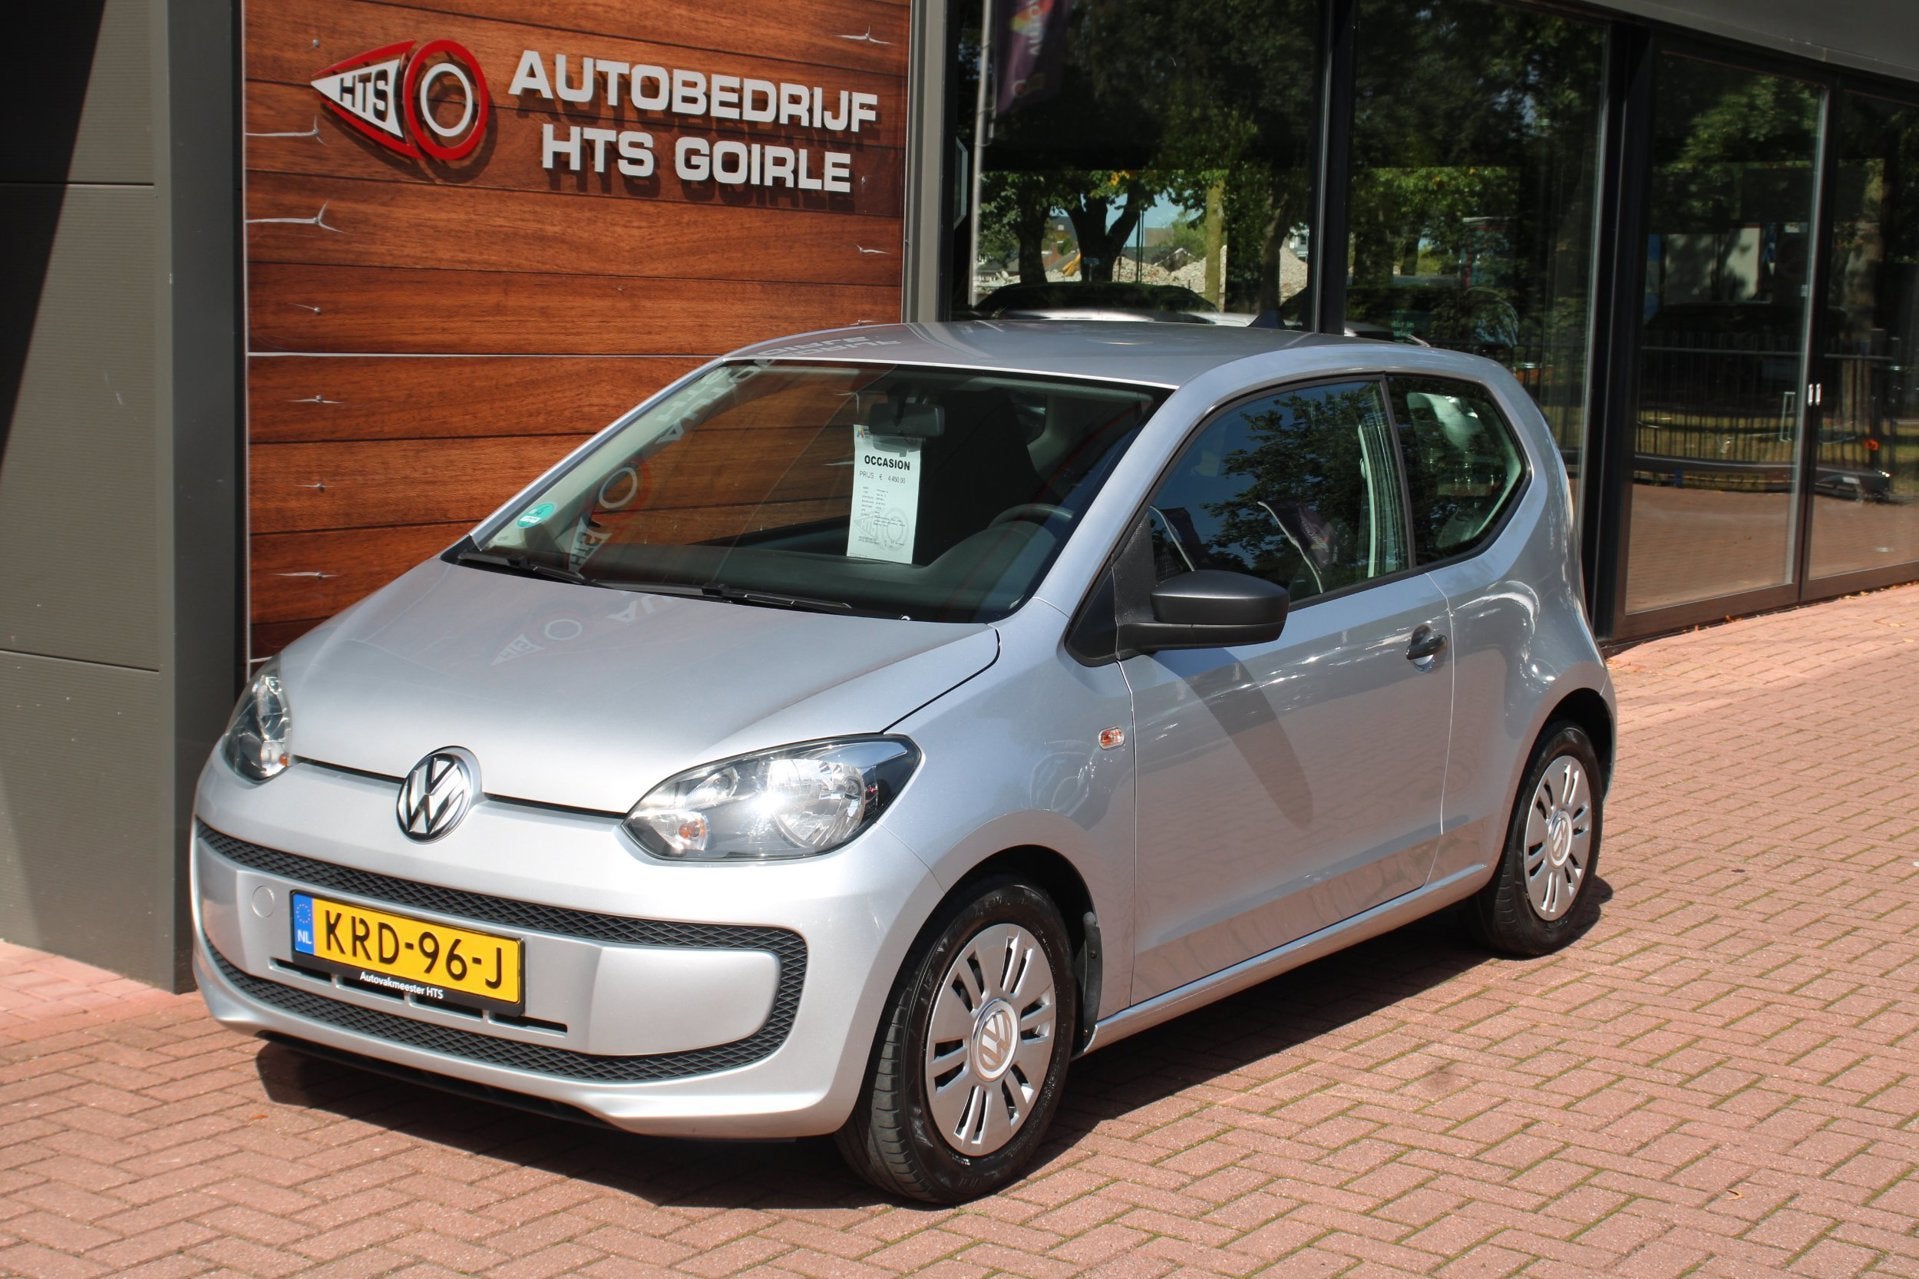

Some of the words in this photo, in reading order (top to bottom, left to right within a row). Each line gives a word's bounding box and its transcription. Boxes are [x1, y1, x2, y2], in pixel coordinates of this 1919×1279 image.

[339, 68, 390, 123] HTS
[507, 49, 878, 133] AUTOBEDRIJF
[541, 123, 656, 177] HTS
[674, 136, 852, 194] GOIRLE
[864, 454, 911, 471] OCCASION
[297, 929, 313, 946] NL
[324, 909, 503, 990] KRD-96-J
[359, 971, 425, 995] Autovakmeester
[425, 985, 445, 1000] HTS
